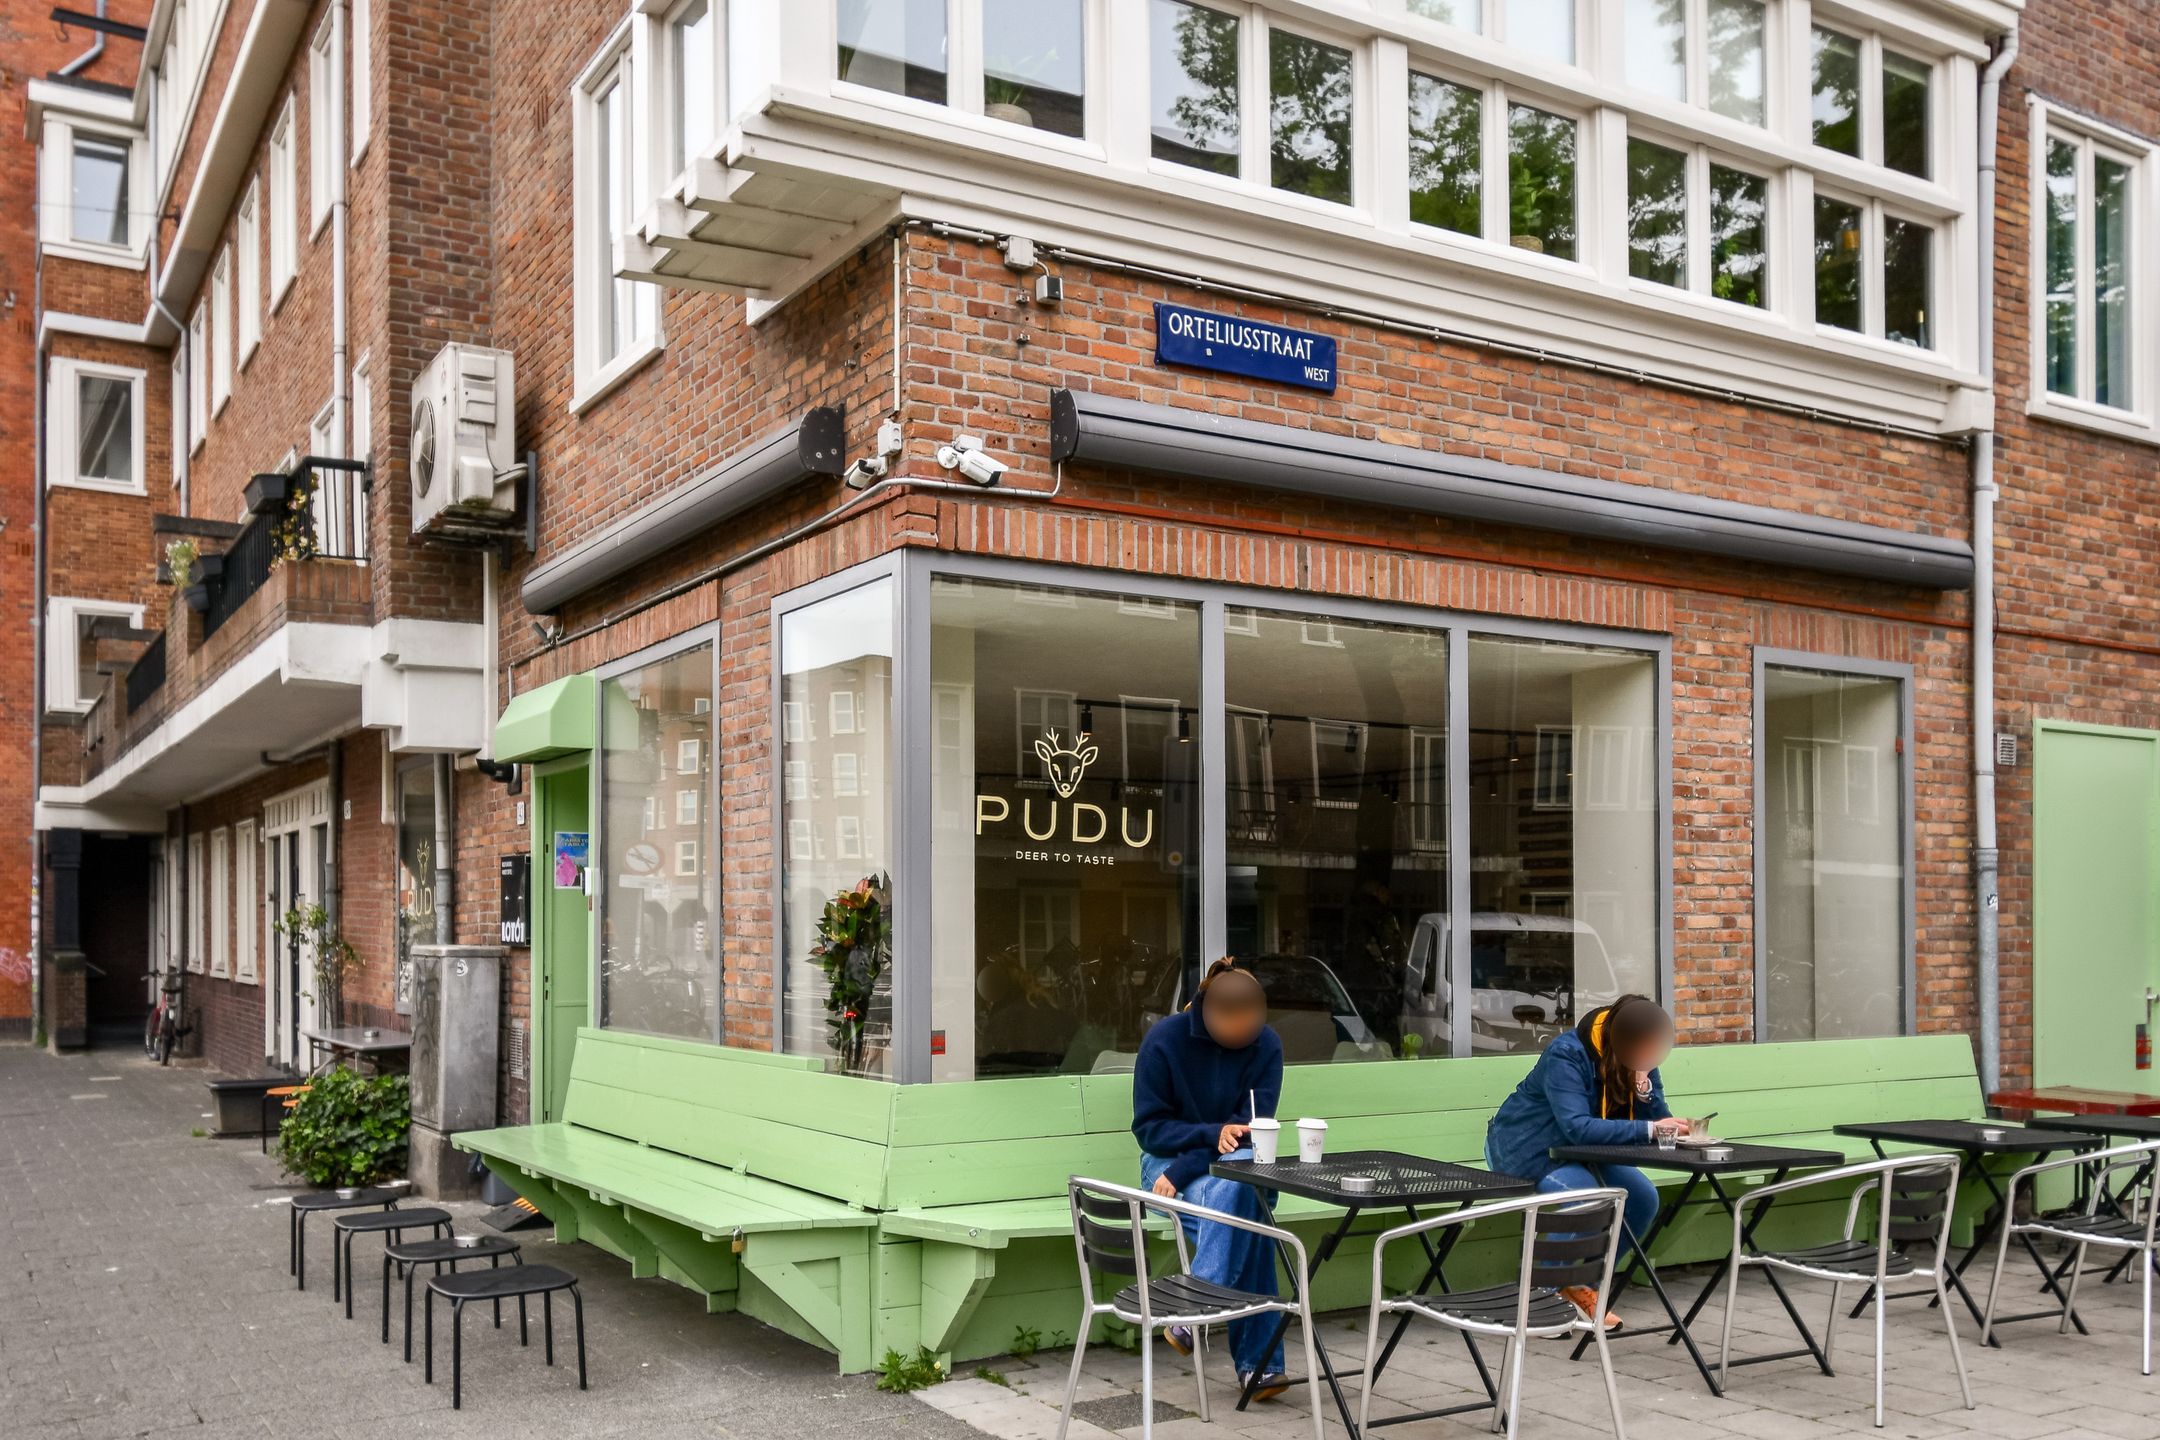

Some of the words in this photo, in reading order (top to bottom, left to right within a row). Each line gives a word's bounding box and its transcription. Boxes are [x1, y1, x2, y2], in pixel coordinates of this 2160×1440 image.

[1168, 312, 1314, 360] ORTELIUSSTRAAT
[1304, 366, 1330, 382] WEST
[975, 795, 1153, 848] PUDU
[1015, 850, 1049, 862] DEER
[1054, 853, 1071, 863] TO
[1076, 854, 1115, 866] TASTE
